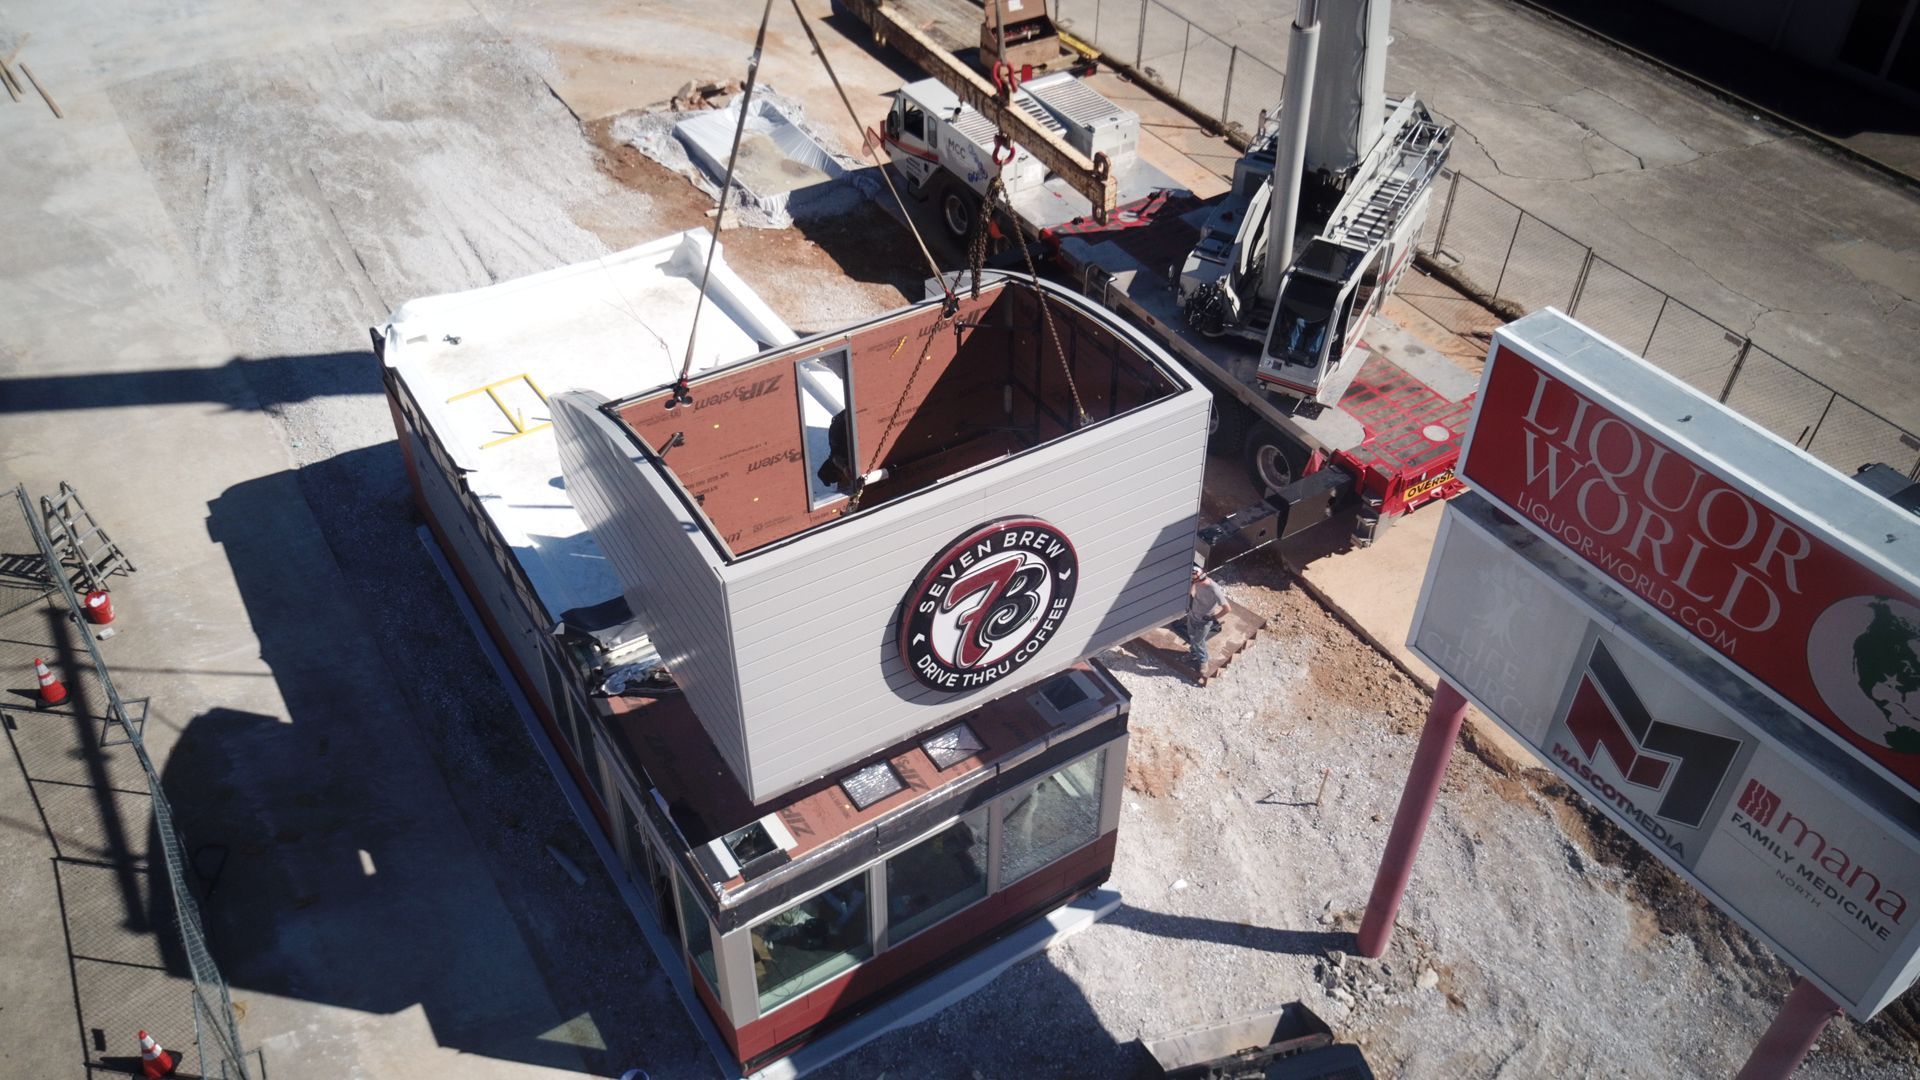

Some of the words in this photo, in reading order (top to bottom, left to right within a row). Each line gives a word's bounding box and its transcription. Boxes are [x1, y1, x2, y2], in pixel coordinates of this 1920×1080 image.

[1521, 367, 1814, 595] LIQUOR
[1522, 426, 1781, 634] WORLD
[919, 540, 992, 613] SEVEN
[1003, 531, 1065, 558] BREW
[1516, 491, 1739, 656] LIQUOR-WORLD.COM
[917, 655, 959, 687] DRIVE
[963, 662, 1010, 687] THRU
[1015, 598, 1067, 663] COFFEE
[1731, 813, 1796, 864] FAMILY
[1796, 863, 1892, 941] MEDICINE
[1776, 868, 1821, 909] NORTH
[1779, 808, 1908, 926] mana
